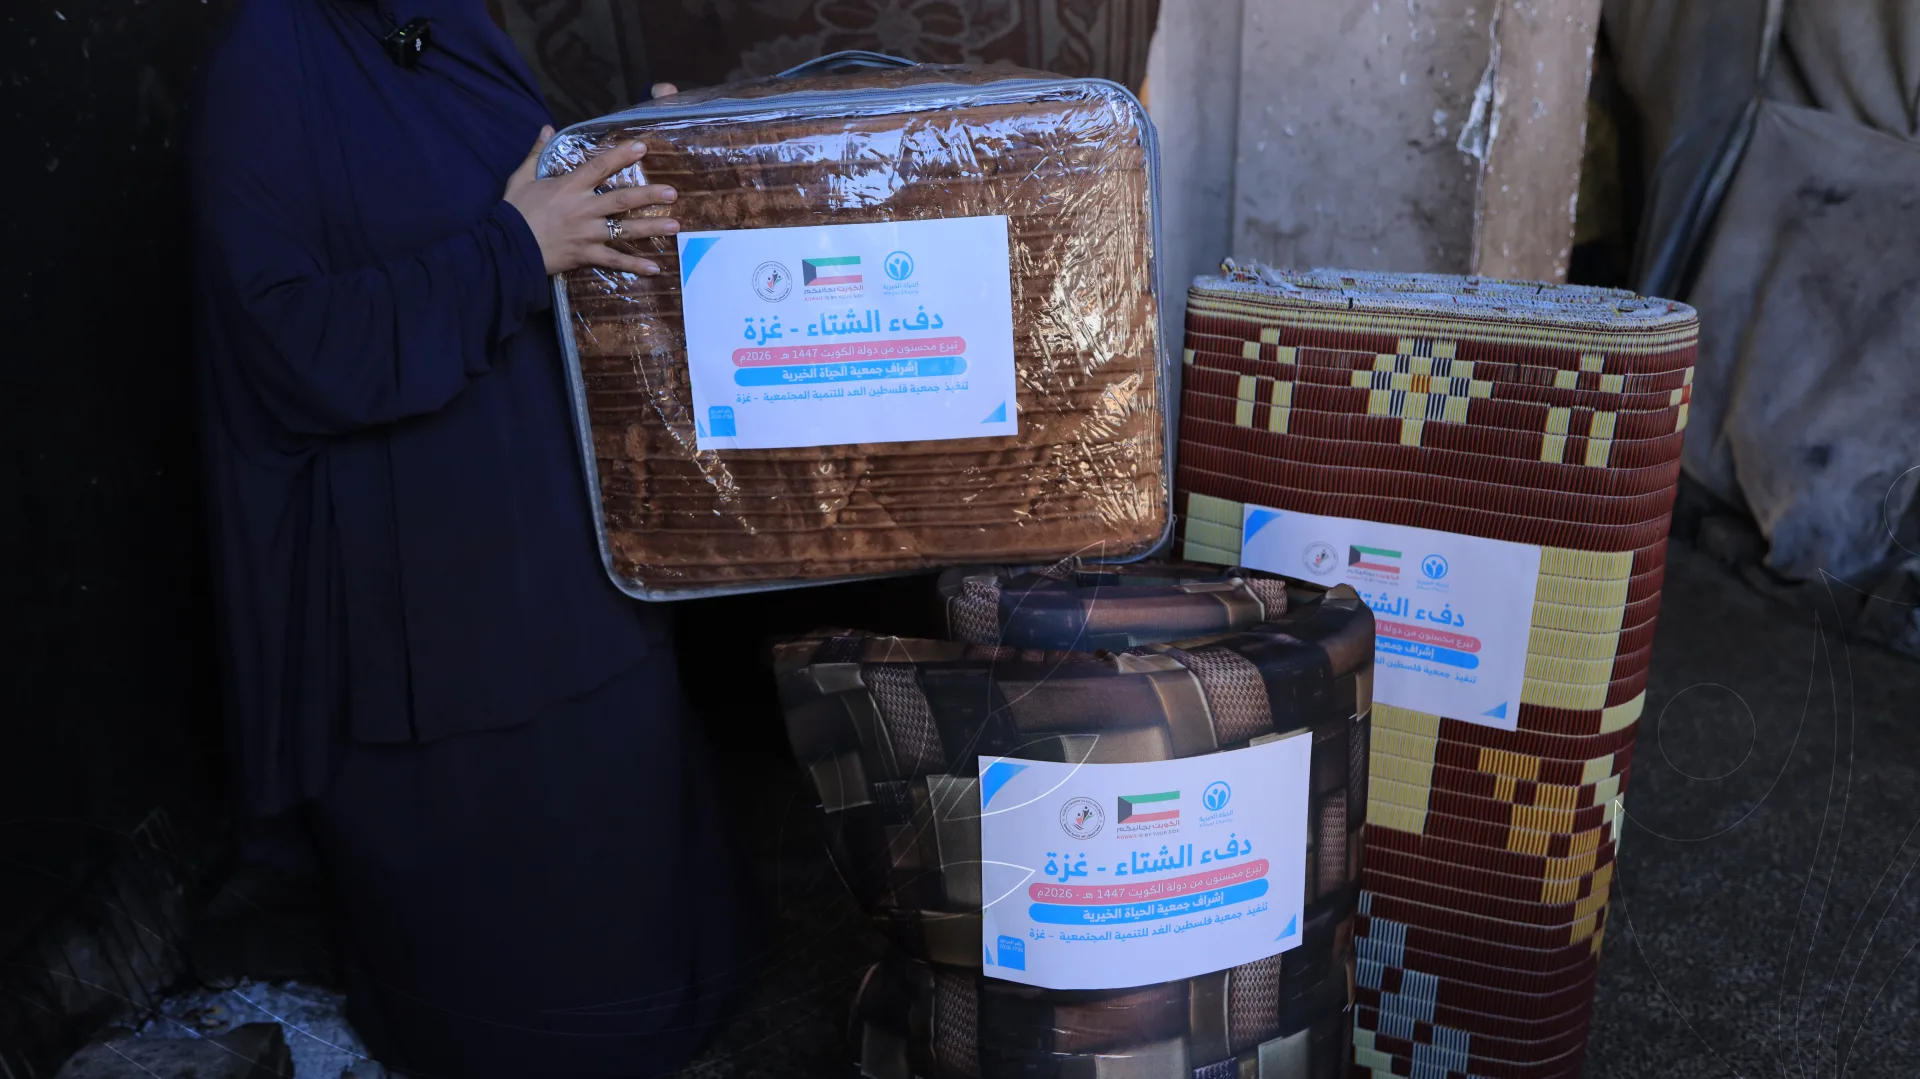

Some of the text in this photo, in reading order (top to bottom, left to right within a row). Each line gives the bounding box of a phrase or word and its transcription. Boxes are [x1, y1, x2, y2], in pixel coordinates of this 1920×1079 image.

[837, 285, 864, 293] الكويت
[807, 308, 881, 337] الشتاء
[888, 305, 944, 332] دفء
[744, 315, 783, 346] غزة
[793, 349, 818, 359] 1447
[821, 346, 853, 358] الكويت
[858, 345, 878, 357] دولة
[881, 347, 895, 356] من
[897, 343, 937, 355] محسنون
[939, 341, 958, 354] تبرع
[782, 360, 919, 381] إشراف جمعية الحياة الخيرية
[847, 387, 866, 397] الغد
[869, 384, 908, 398] فلسطين
[910, 384, 940, 395] جمعية
[944, 381, 969, 393] تنفيذ
[736, 393, 752, 405] غزة
[763, 390, 810, 403] المجتمعية
[813, 388, 845, 400] للتنمية
[1415, 603, 1465, 628] دفء
[1384, 623, 1403, 635] دولة
[1404, 628, 1417, 637] من
[1418, 631, 1455, 644] محسنون
[1456, 637, 1474, 649] تبرع
[1404, 644, 1435, 660] إشراف
[1386, 659, 1422, 673] فلسطين
[1423, 666, 1451, 679] جمعية
[1454, 674, 1477, 685] تنفيذ
[1116, 820, 1180, 833] الكويت بجانبكم
[1199, 832, 1253, 866] دفء
[1115, 843, 1193, 877] الشتاء
[1044, 852, 1088, 883] غزة
[1245, 864, 1263, 878] تبرع
[1190, 880, 1204, 890] من
[1205, 870, 1244, 887] محسنون
[1129, 883, 1164, 898] الكويت
[1166, 880, 1187, 893] دولة
[1097, 888, 1125, 899] 1447
[1083, 891, 1225, 922] إشراف جمعية الحياة الخيرية
[1246, 901, 1269, 917] تنفيذ
[1173, 915, 1212, 934] فلسطين
[1215, 911, 1243, 925] جمعية
[1029, 928, 1046, 941] غزة
[1115, 928, 1149, 941] للتنمية
[1152, 924, 1171, 936] الغد
[1059, 930, 1112, 944] المجتمعية
